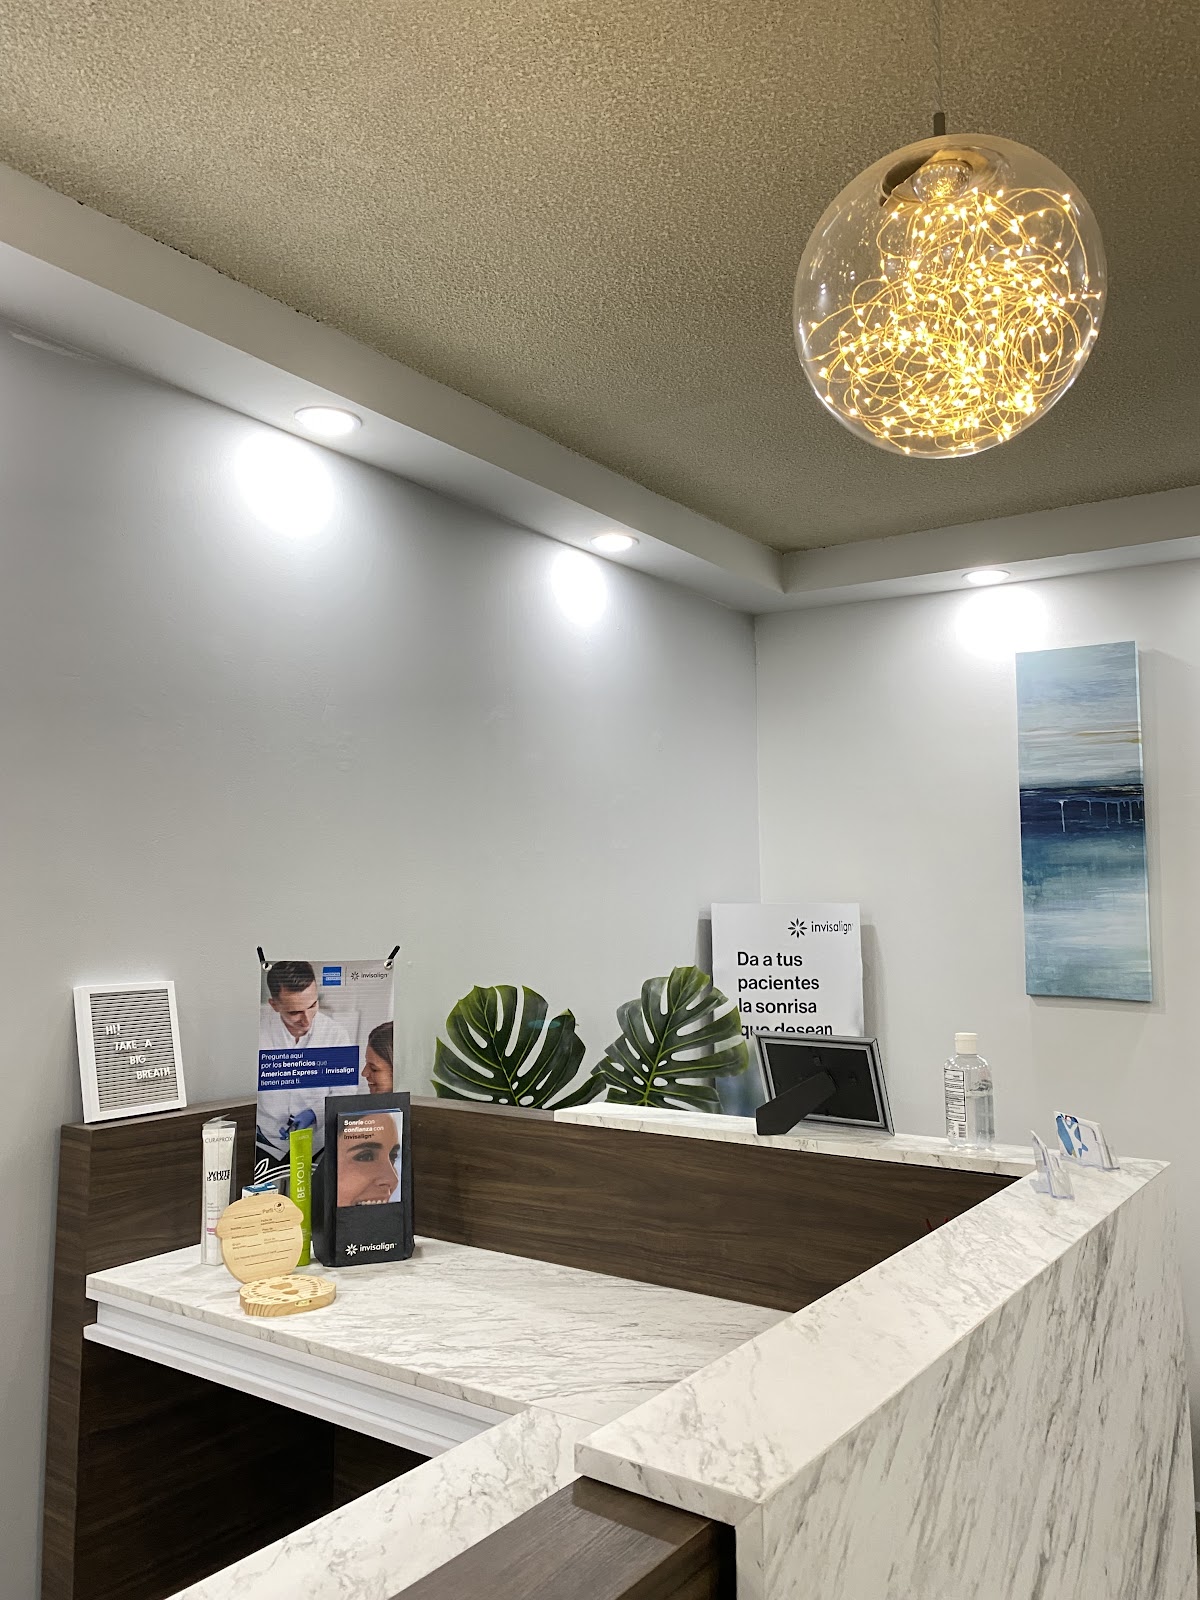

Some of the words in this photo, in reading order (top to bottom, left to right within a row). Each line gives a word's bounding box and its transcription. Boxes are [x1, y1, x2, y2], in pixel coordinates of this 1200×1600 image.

[811, 921, 852, 935] invisalign
[737, 951, 759, 967] Da
[762, 956, 773, 967] a
[776, 952, 803, 967] tus
[361, 971, 388, 980] invisalign
[738, 975, 820, 993] pacientes
[738, 997, 752, 1013] la
[755, 998, 817, 1014] sonrisa
[105, 1023, 120, 1035] HI!
[114, 1040, 138, 1051] TAKE
[144, 1039, 152, 1048] A
[129, 1054, 146, 1065] BIG
[261, 1053, 289, 1061] Pregunta
[260, 1062, 272, 1070] por
[272, 1061, 282, 1069] los
[282, 1060, 316, 1068] beneficios
[136, 1066, 171, 1080] BREATH
[260, 1070, 292, 1078] American
[292, 1069, 318, 1077] Express
[325, 1067, 355, 1075] Invisalign
[260, 1079, 280, 1087] tienen
[343, 1126, 373, 1134] confianza
[208, 1169, 231, 1179] WHITE
[359, 1242, 395, 1252] invisalign
